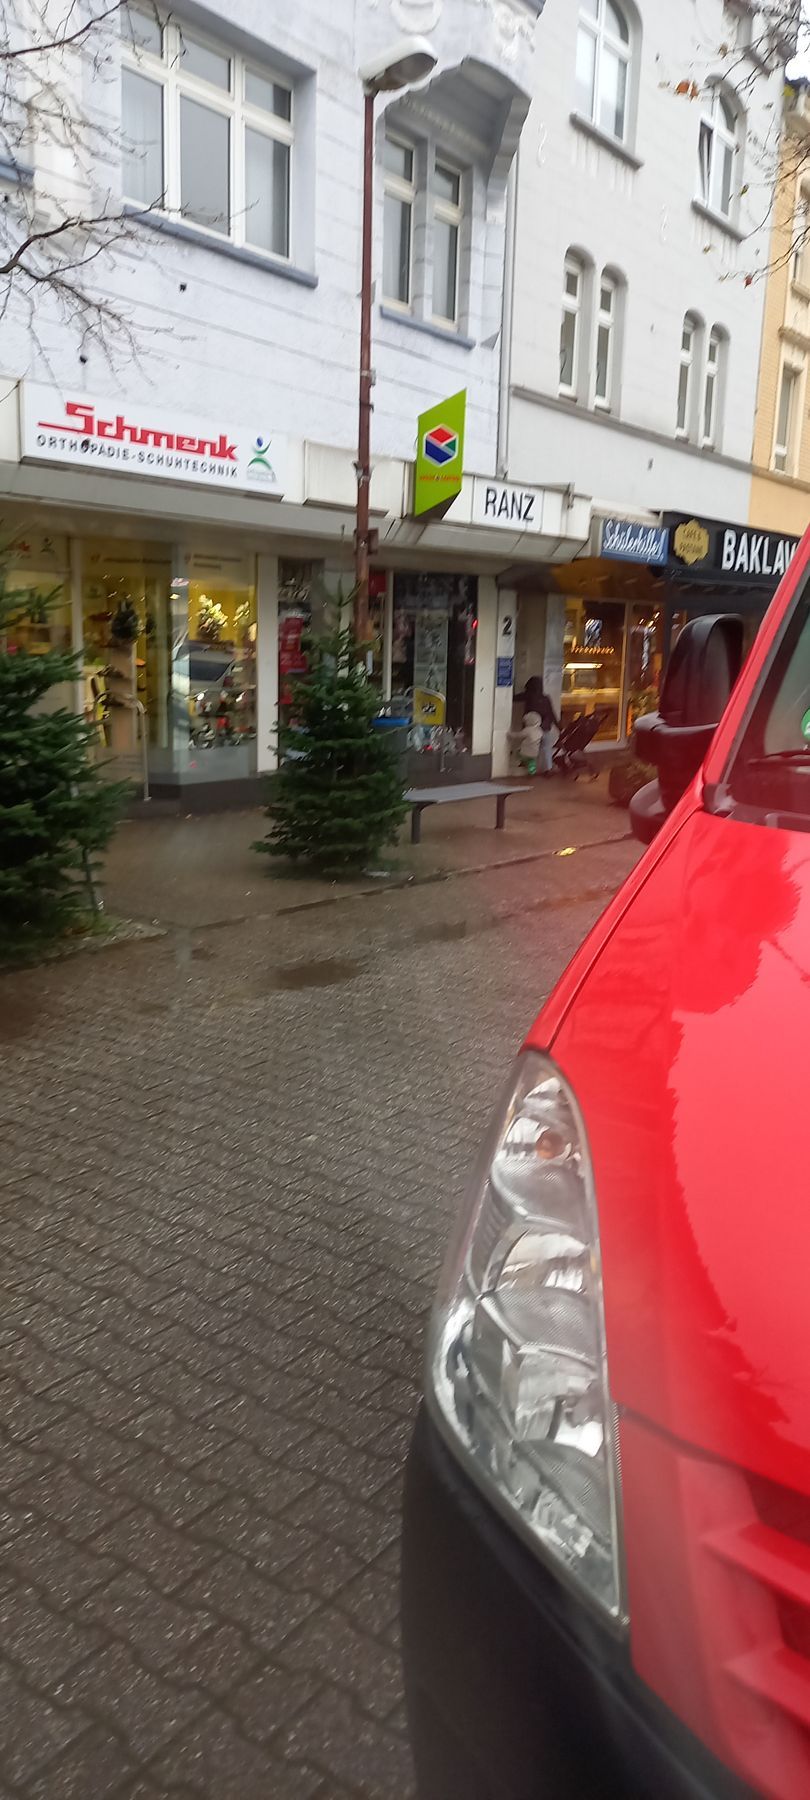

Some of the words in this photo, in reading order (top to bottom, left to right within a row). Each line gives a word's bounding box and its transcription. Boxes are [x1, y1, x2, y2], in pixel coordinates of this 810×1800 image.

[37, 400, 239, 463] Schmenk
[484, 487, 536, 522] RANZ
[502, 616, 512, 636] 2
